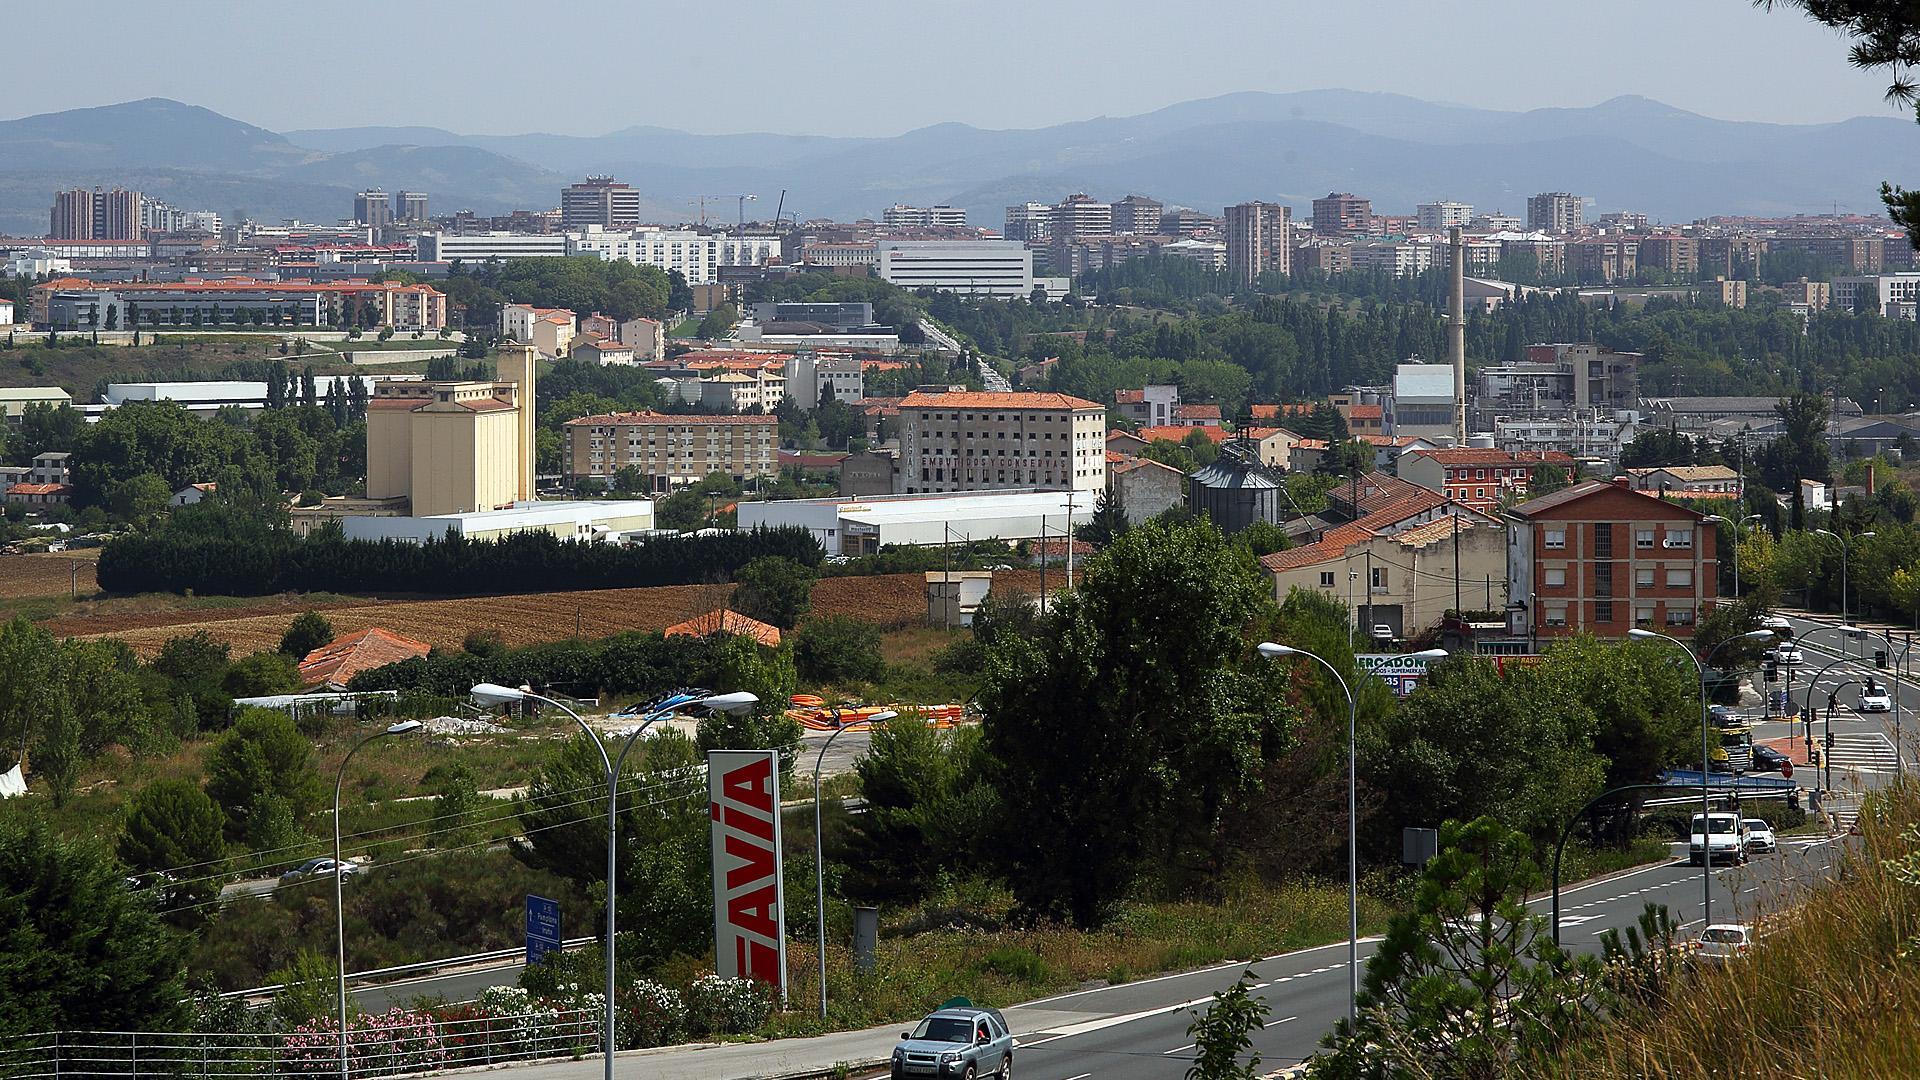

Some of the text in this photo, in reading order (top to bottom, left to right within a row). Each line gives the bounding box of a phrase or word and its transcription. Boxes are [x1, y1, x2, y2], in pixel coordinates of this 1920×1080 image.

[922, 457, 986, 467] EMBUTIDOS
[1000, 458, 1065, 468] CONSERVAS
[1355, 657, 1428, 668] ERCADON
[1384, 677, 1398, 686] 35
